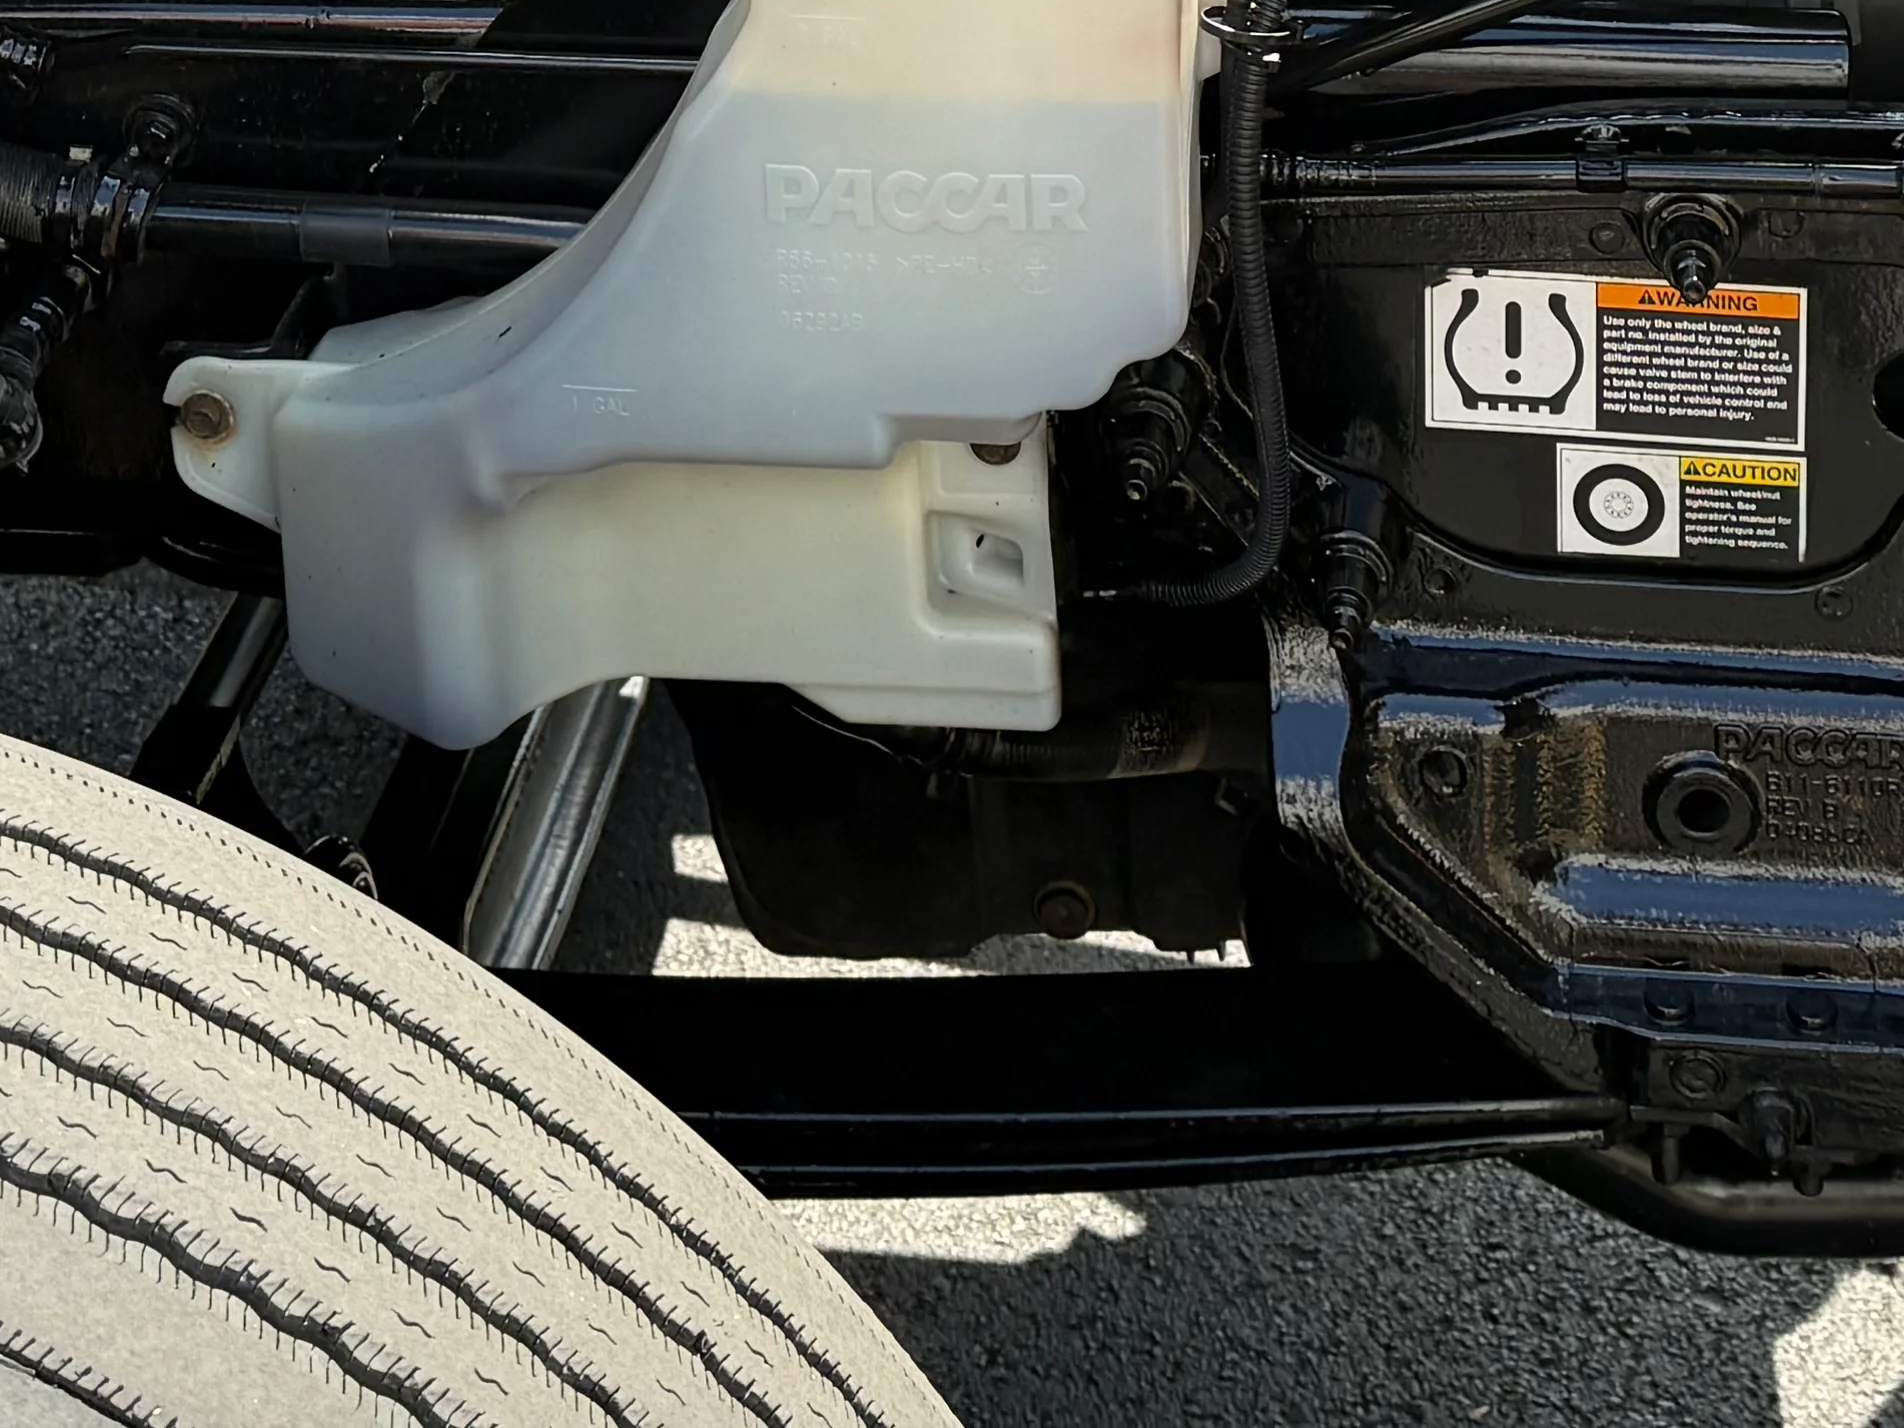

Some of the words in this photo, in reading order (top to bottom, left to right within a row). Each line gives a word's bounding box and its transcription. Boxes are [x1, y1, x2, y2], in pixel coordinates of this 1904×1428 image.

[765, 163, 1088, 234] PACCAR
[1656, 290, 1758, 311] WANING
[1604, 316, 1624, 326] Use
[1628, 318, 1651, 329] only
[1655, 319, 1672, 328] the
[1675, 320, 1706, 330] wheel
[1710, 322, 1745, 334] brand,
[1748, 324, 1770, 335] size
[1604, 329, 1625, 340] part
[1629, 332, 1646, 340] no.
[1648, 331, 1695, 343] installed
[1699, 334, 1712, 346] by
[1715, 335, 1732, 344] the
[1735, 337, 1776, 348] original
[1603, 342, 1661, 354] equipment
[1664, 346, 1741, 358] manufacturer.
[1744, 348, 1765, 359] Use
[1768, 350, 1780, 360] of
[1603, 354, 1649, 364] different
[1653, 356, 1684, 366] wheel
[1687, 358, 1719, 368] brand
[1737, 362, 1758, 371] size
[1762, 363, 1792, 373] could
[1603, 367, 1636, 376] cause
[1639, 367, 1667, 378] valve
[1671, 369, 1697, 379] stem
[1701, 371, 1711, 381] to
[1715, 371, 1760, 384] interfere
[1764, 374, 1786, 385] with
[1613, 378, 1643, 389] brake
[1647, 381, 1708, 393] component
[1711, 384, 1743, 395] which
[1747, 386, 1777, 397] could
[593, 396, 629, 416] GAL
[1603, 389, 1626, 399] lead
[1630, 391, 1640, 400] to
[1643, 392, 1665, 402] loss
[1669, 394, 1680, 403] of
[1683, 395, 1722, 405] vehicle
[1725, 398, 1764, 408] control
[1768, 400, 1787, 410] and
[1603, 403, 1626, 413] may
[1630, 402, 1652, 413] lead
[1655, 405, 1666, 414] to
[1669, 406, 1717, 418] personal
[1720, 409, 1754, 421] injury.
[1702, 462, 1797, 482] CAUTION
